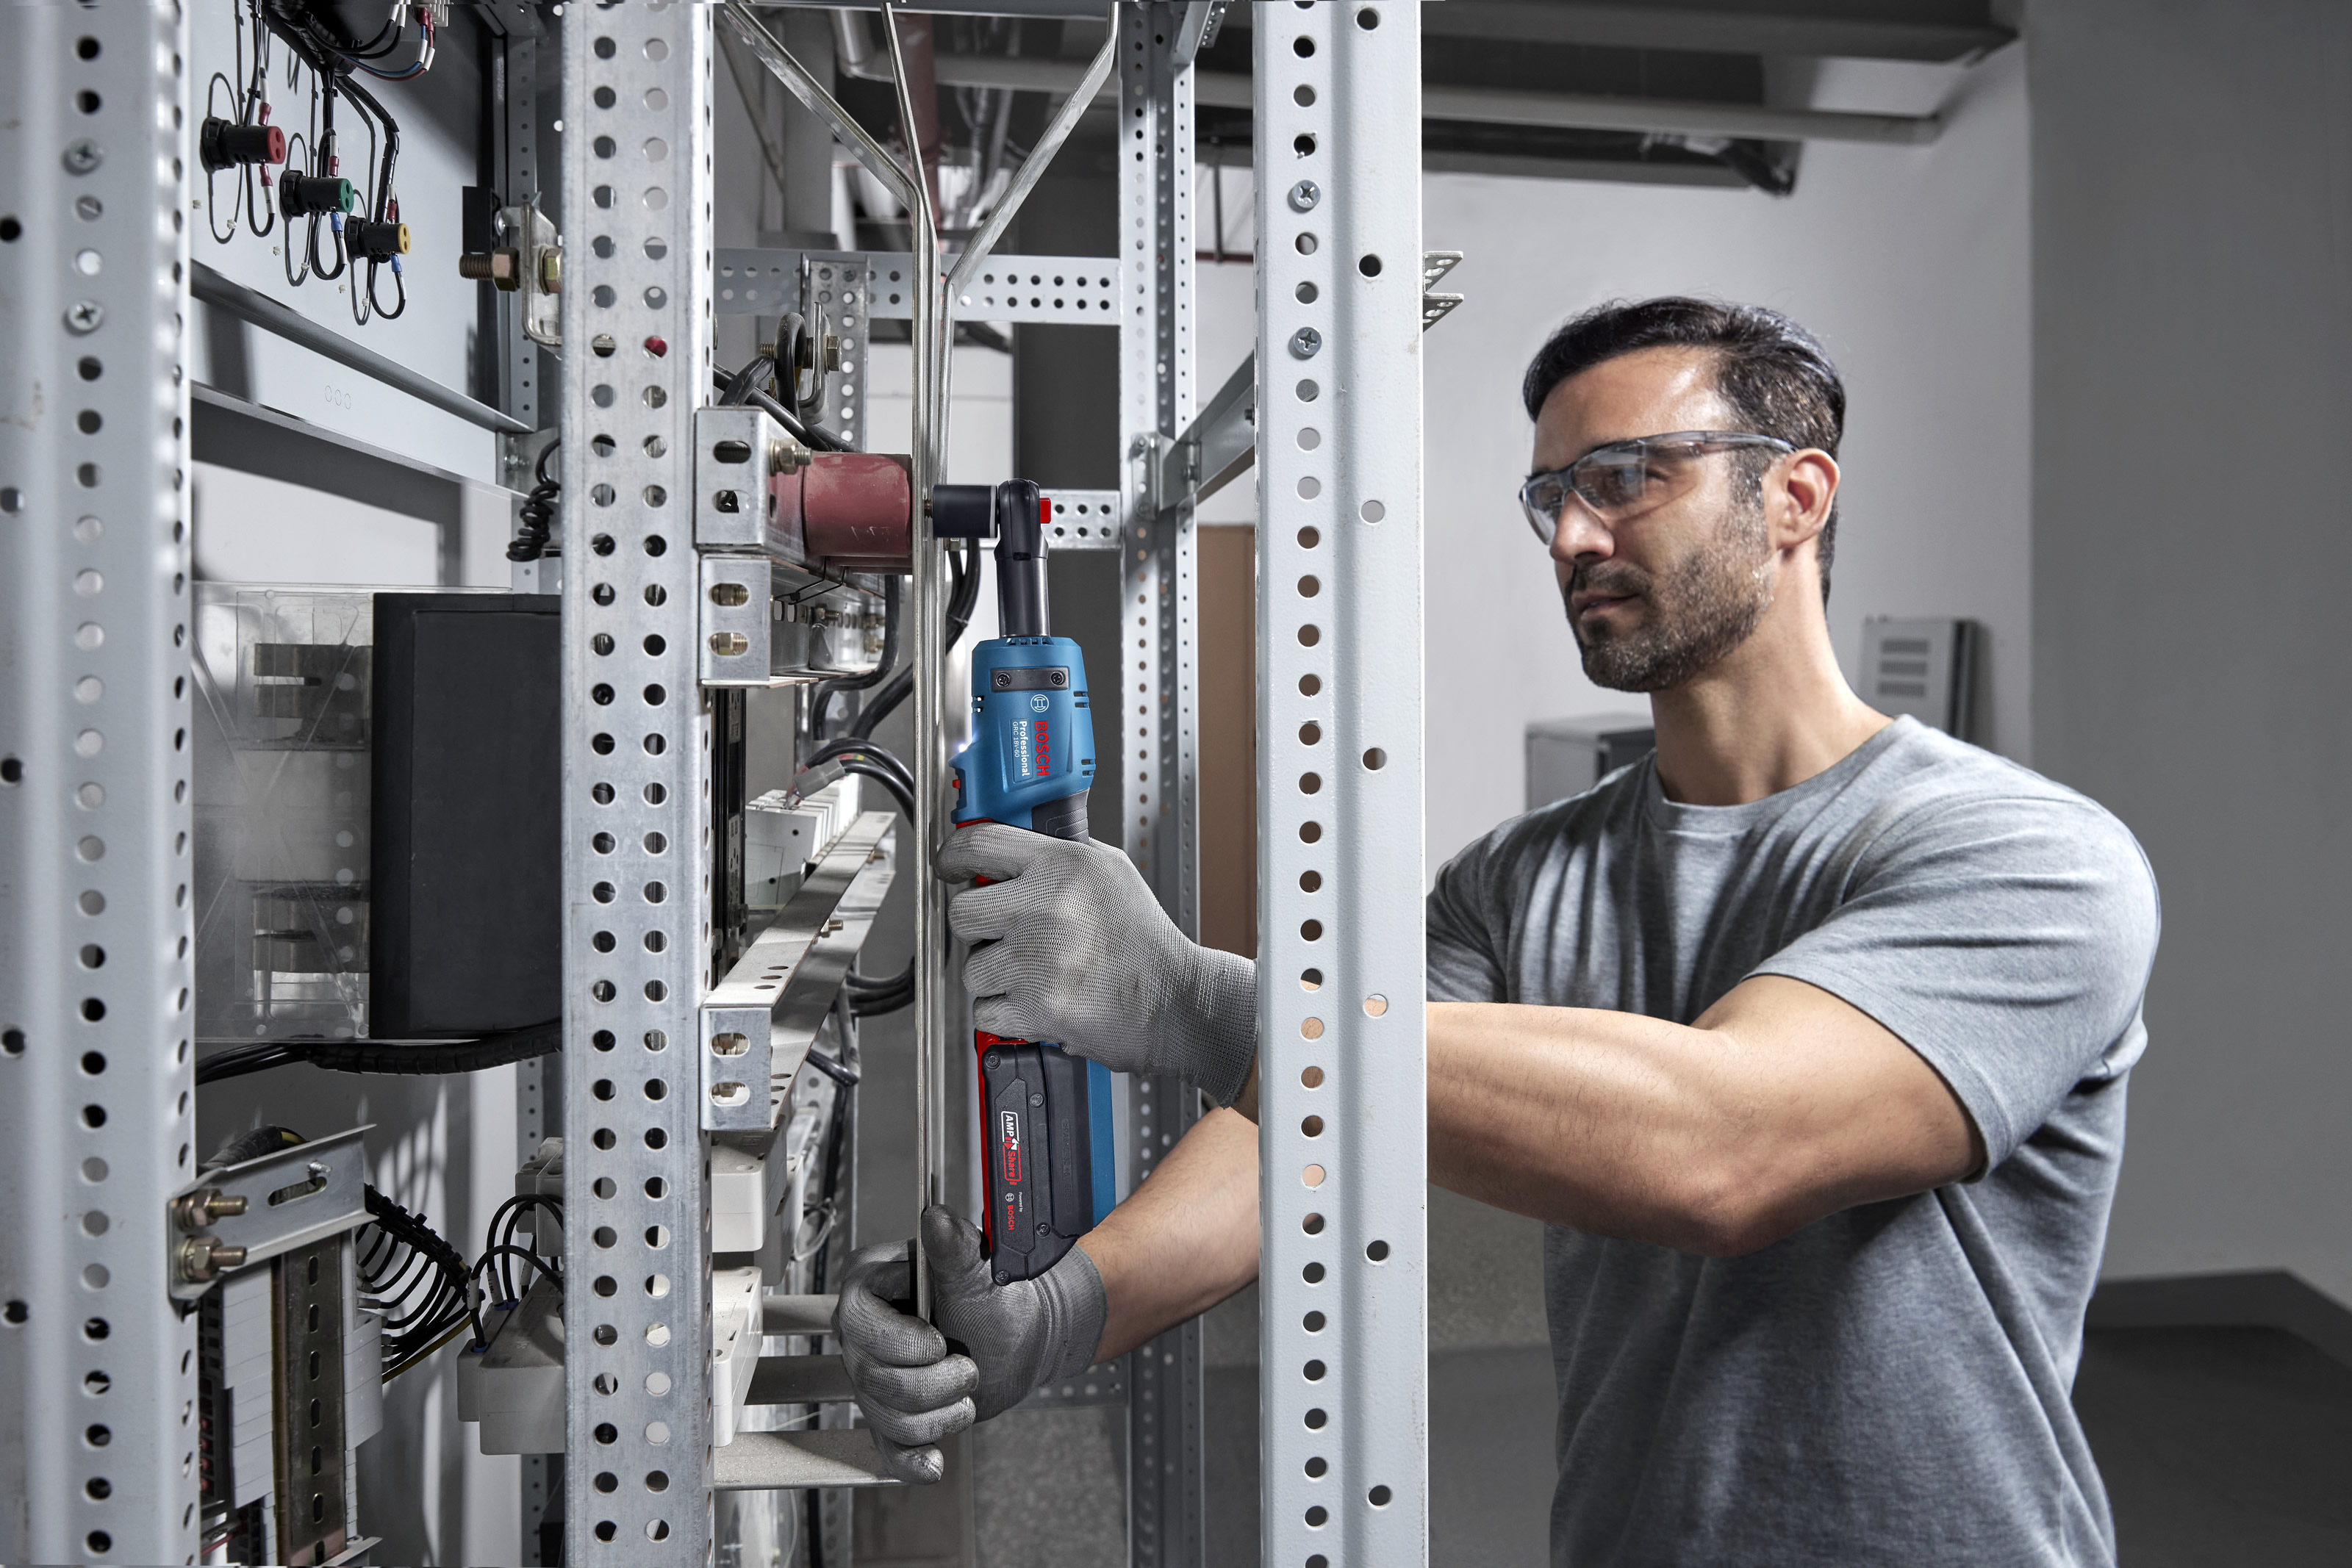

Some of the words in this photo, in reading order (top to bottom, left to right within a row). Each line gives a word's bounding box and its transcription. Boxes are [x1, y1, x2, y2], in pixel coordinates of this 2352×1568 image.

[1019, 721, 1030, 777] Professional
[1035, 721, 1050, 776] BOSCH
[1006, 1115, 1014, 1137] AMP
[1008, 1151, 1017, 1177] Share
[1007, 1204, 1015, 1231] BOSCH
